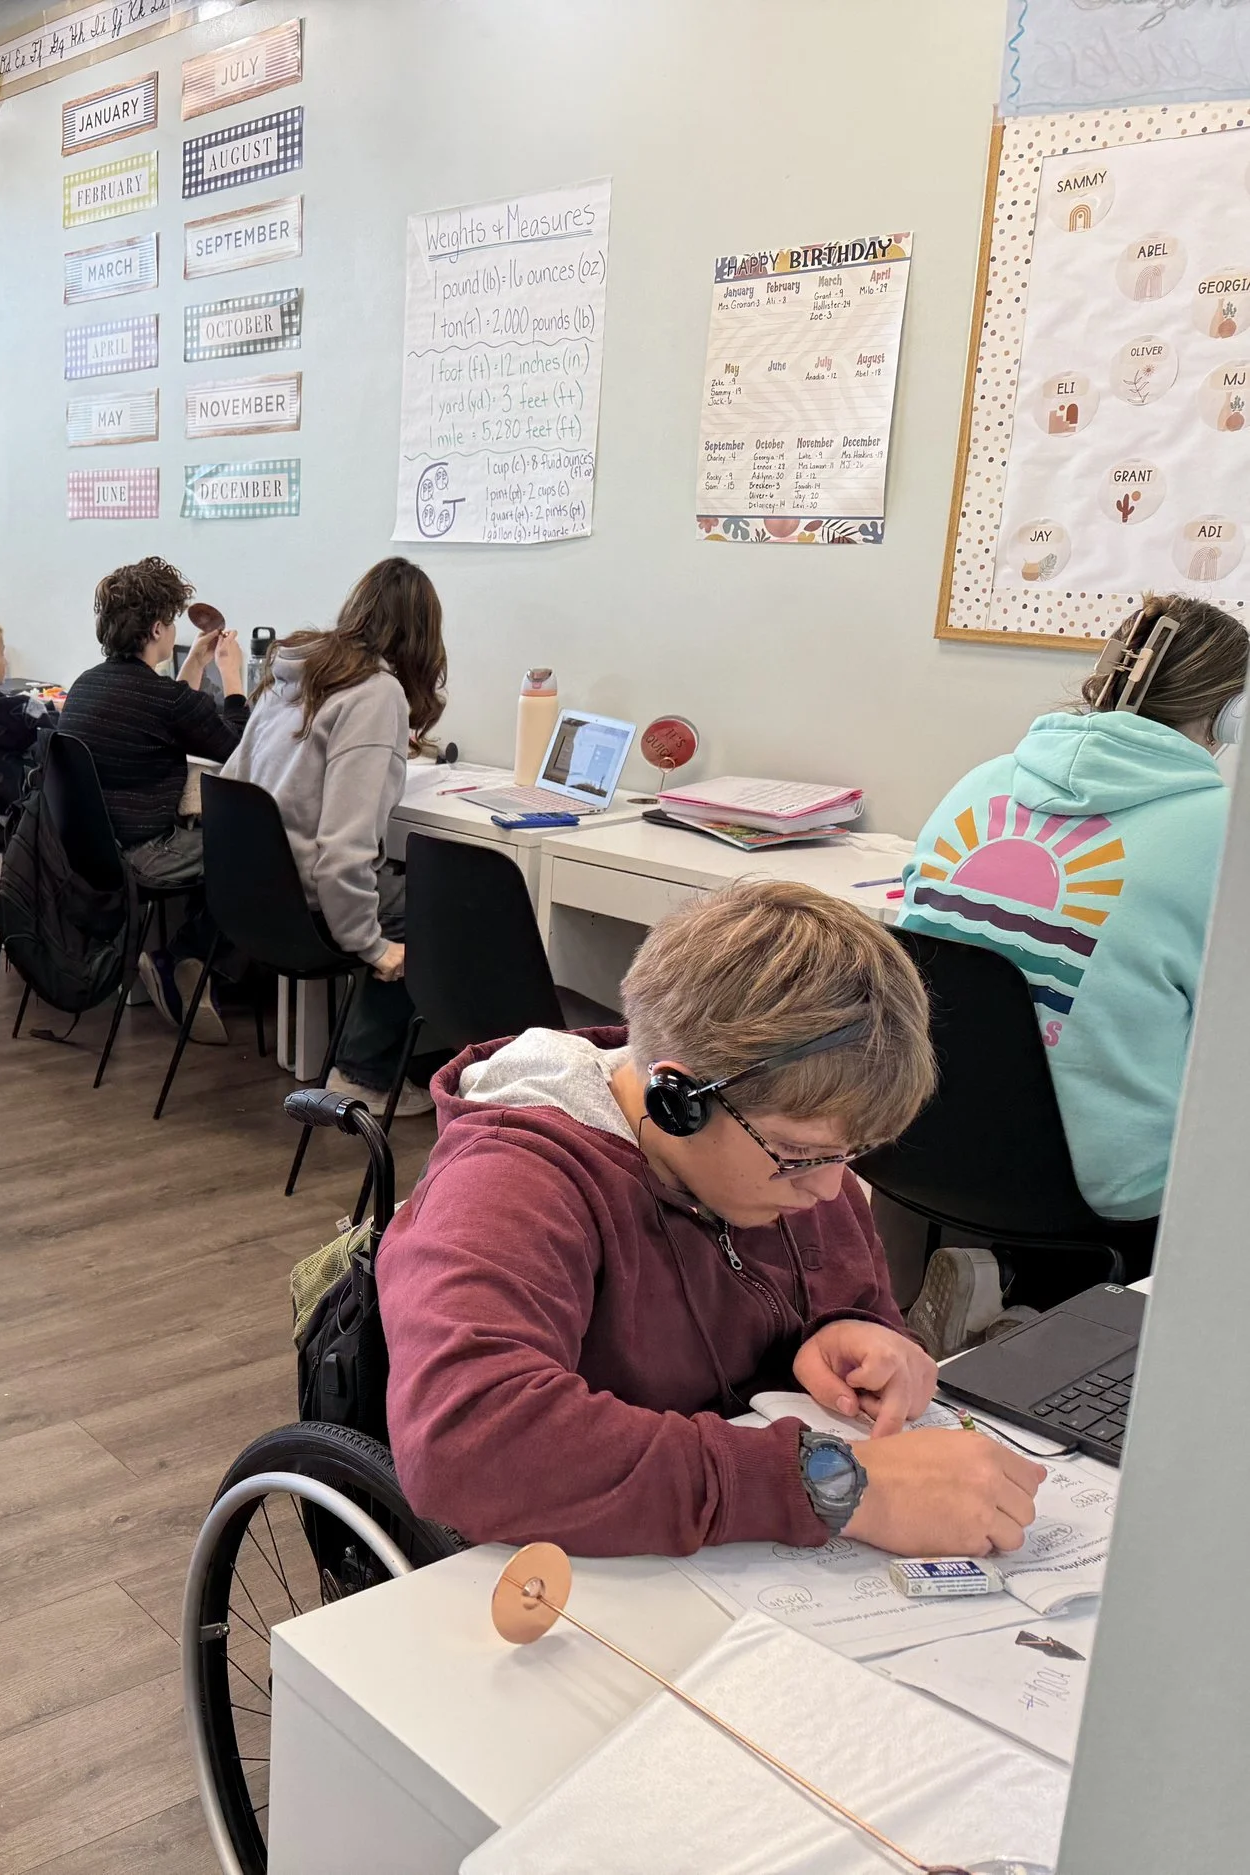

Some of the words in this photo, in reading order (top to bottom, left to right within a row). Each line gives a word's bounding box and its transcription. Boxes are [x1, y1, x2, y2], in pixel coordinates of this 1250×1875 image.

[221, 56, 260, 86] JULY
[78, 97, 140, 133] JANUARY
[208, 134, 276, 172] AUGUST
[77, 173, 143, 207] FEBRUARY
[1056, 170, 1107, 194] SAMMY
[196, 220, 290, 257] SEPTEMBER
[425, 210, 486, 264] Weights
[507, 204, 595, 240] Measures
[727, 252, 780, 277] HAPPY
[789, 238, 893, 269] BIRTHDAY
[1137, 243, 1168, 259] ABEL
[87, 257, 133, 282] MARCH
[443, 270, 479, 308] pound
[510, 258, 523, 289] 16
[527, 264, 575, 285] ounces
[724, 287, 755, 299] January
[766, 281, 801, 294] February
[818, 274, 842, 287] March
[869, 267, 891, 284] April
[859, 286, 874, 295] Milo
[1198, 277, 1250, 295] GEORGI
[814, 291, 832, 300] Grant
[205, 313, 274, 340] OCTOBER
[493, 306, 529, 335] 2,000
[533, 308, 570, 343] pounds
[91, 337, 128, 359] APRIL
[1130, 345, 1163, 357] OLIVER
[439, 358, 463, 381] foot
[501, 352, 515, 377] 12
[519, 350, 561, 374] inches
[724, 363, 739, 377] May
[768, 360, 787, 372] June
[815, 356, 833, 371] July
[856, 353, 885, 368] August
[1057, 381, 1075, 395] ELI
[1223, 372, 1247, 386] MJ
[199, 394, 286, 419] NOVEMBER
[439, 392, 465, 422] yard
[502, 384, 512, 413] 3
[519, 382, 549, 409] feet
[97, 409, 123, 428] MAY
[438, 422, 464, 447] mile
[482, 418, 520, 443] 5,280
[526, 416, 552, 439] feet
[704, 440, 745, 453] September
[755, 439, 785, 450] October
[796, 437, 834, 448] November
[842, 435, 881, 447] December
[493, 462, 510, 480] cup
[531, 454, 538, 471] 8
[541, 452, 562, 470] fluid
[563, 451, 594, 467] ounces
[1113, 469, 1153, 483] GRANT
[96, 486, 127, 504] JUNE
[200, 479, 283, 501] DECEMBER
[490, 486, 508, 507] pint
[528, 482, 535, 501] 2
[537, 486, 557, 504] cups
[491, 508, 514, 528] quart
[536, 505, 544, 520] 2
[546, 504, 568, 521] pints
[487, 527, 512, 543] gallon
[533, 525, 540, 540] 4
[1030, 530, 1053, 543] JAY
[1197, 525, 1223, 538] ADI
[665, 728, 686, 748] IT'S
